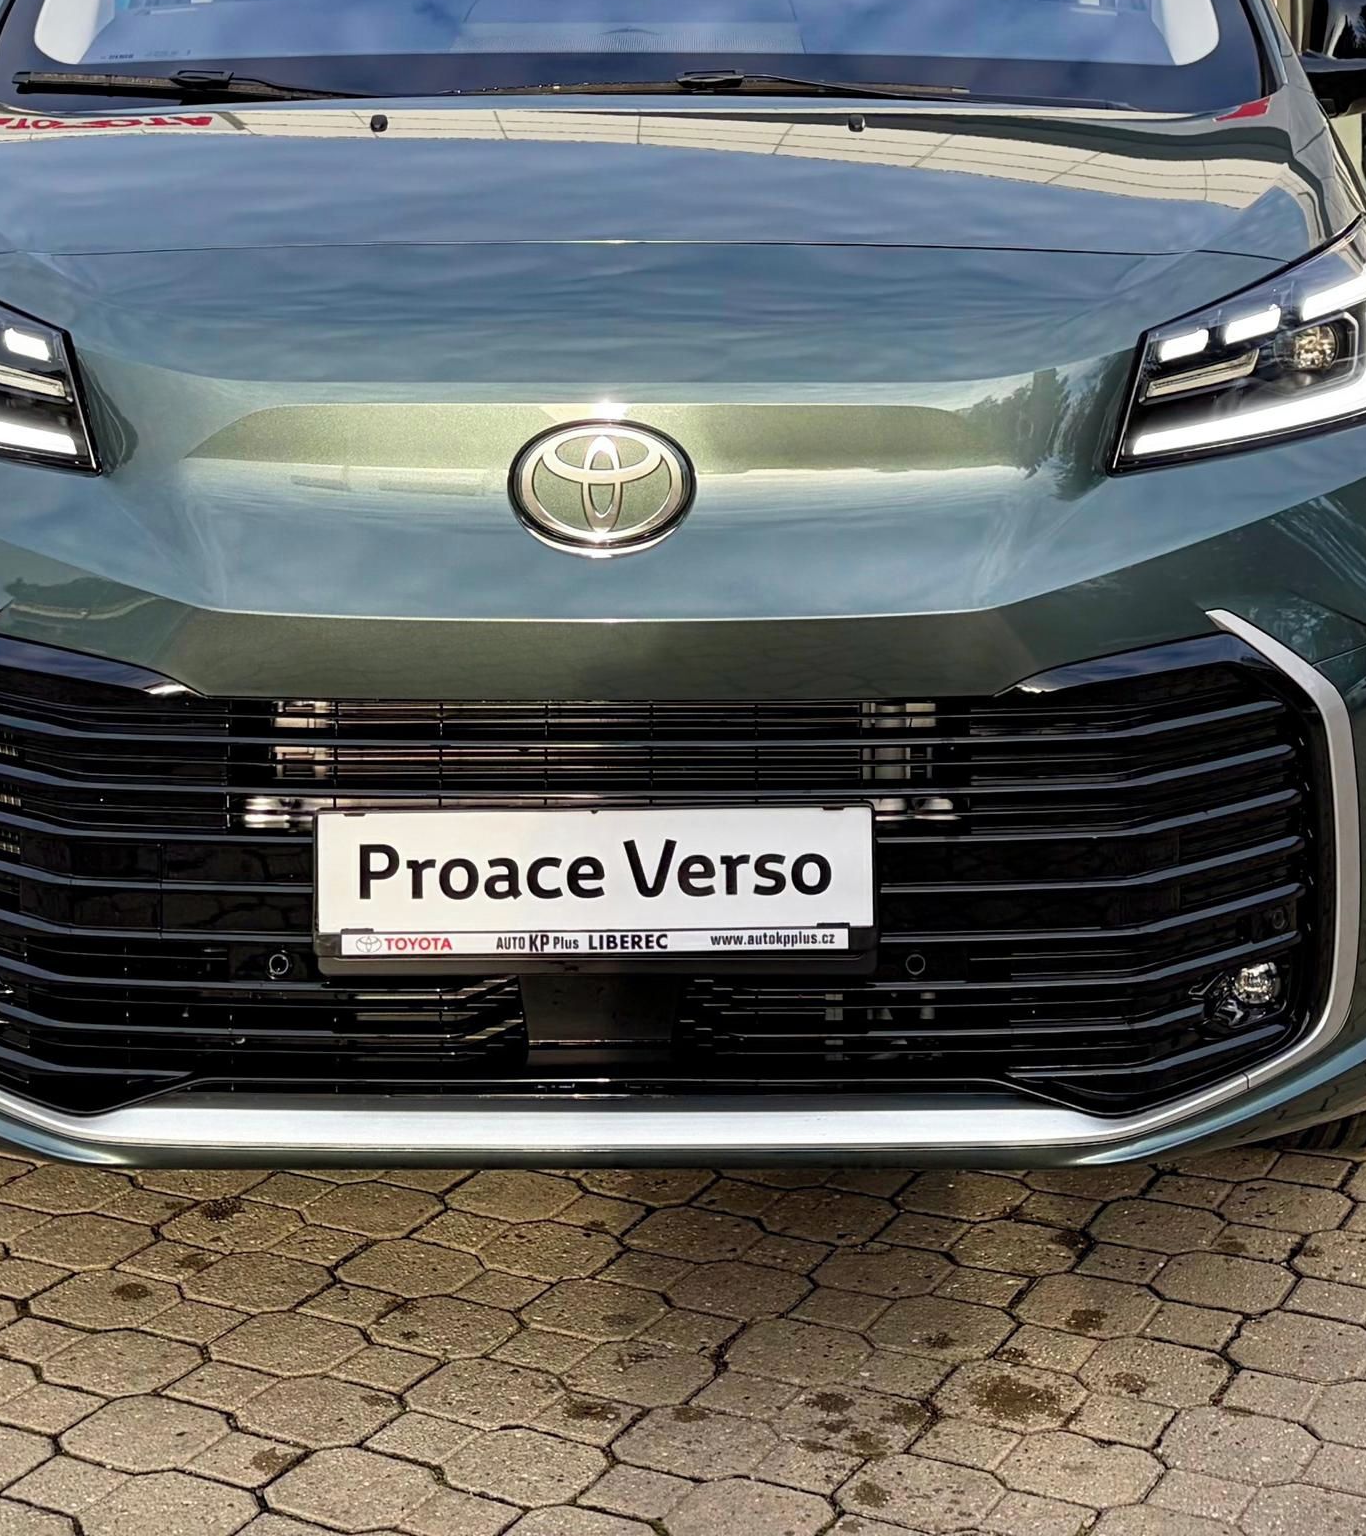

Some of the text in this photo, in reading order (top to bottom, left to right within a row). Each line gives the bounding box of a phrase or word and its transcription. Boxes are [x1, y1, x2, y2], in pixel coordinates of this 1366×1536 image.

[358, 838, 833, 901] Proace Verso
[384, 930, 836, 952] TOYOTA AUTO KP Plus LIBEREC www.autokpplus.cz
